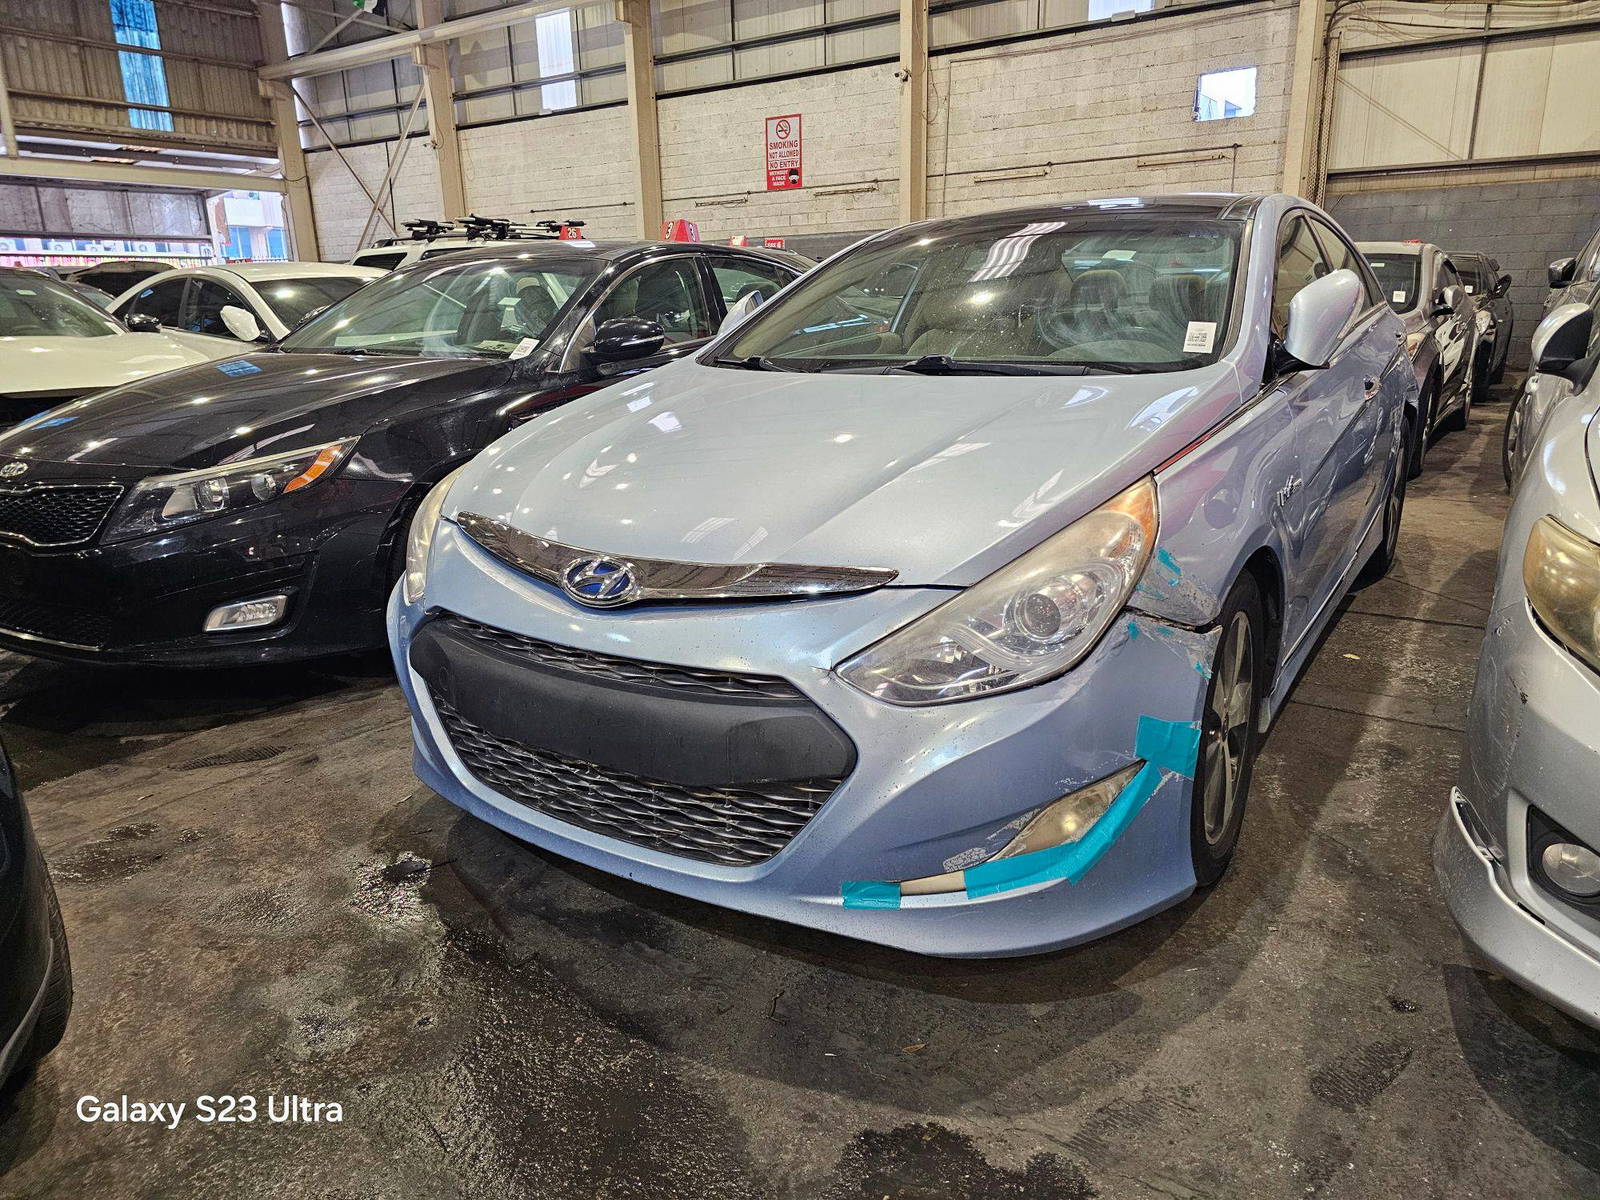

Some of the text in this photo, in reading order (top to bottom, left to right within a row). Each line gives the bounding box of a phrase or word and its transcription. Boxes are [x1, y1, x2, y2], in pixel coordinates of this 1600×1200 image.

[769, 140, 798, 150] SMOKING
[769, 149, 799, 159] NOT ALLOWED
[780, 160, 799, 168] ENTRY
[567, 228, 577, 238] 26
[665, 221, 674, 240] 3
